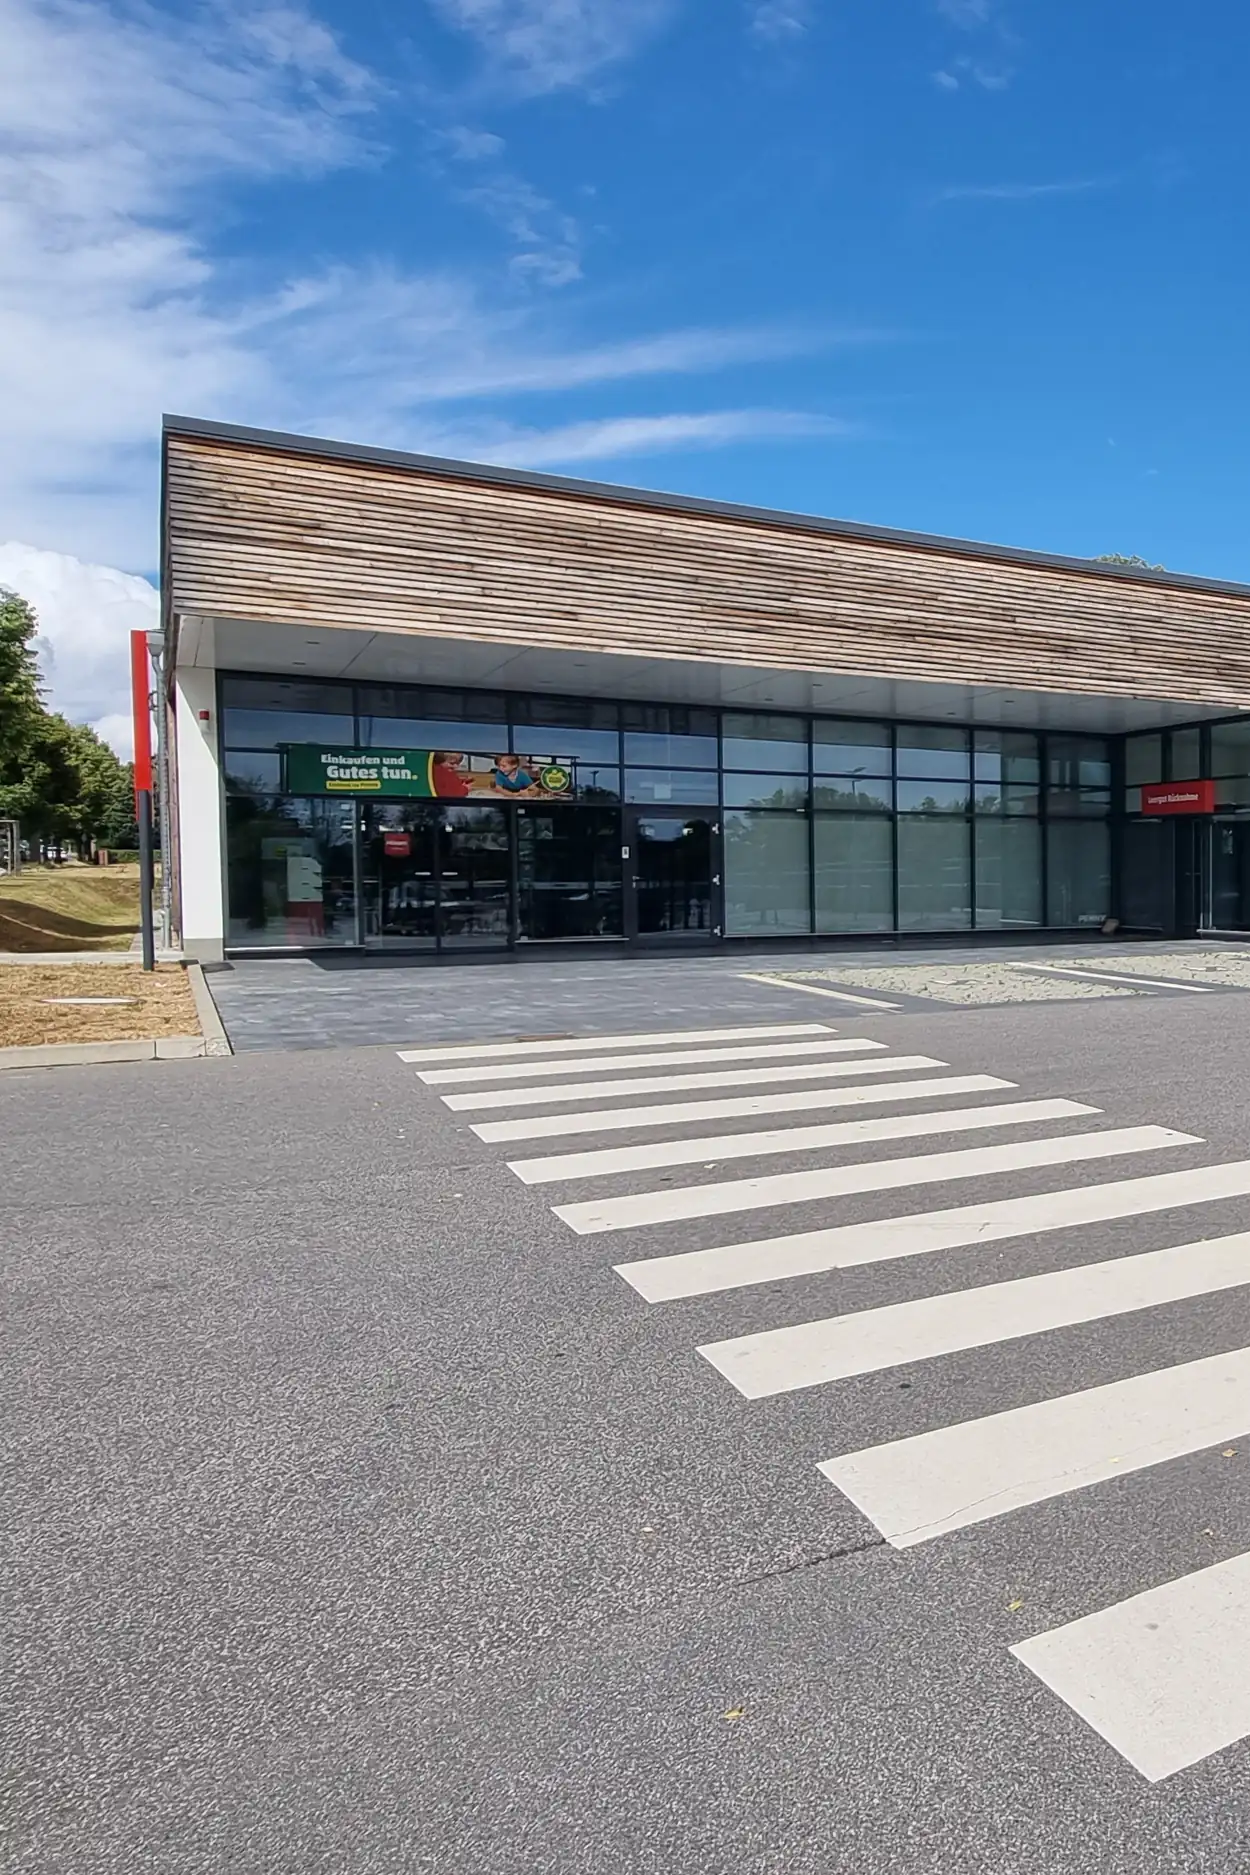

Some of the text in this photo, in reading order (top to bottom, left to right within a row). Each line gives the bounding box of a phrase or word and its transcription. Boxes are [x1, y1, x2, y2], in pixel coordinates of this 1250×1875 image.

[321, 753, 405, 765] Einkaufen und
[326, 765, 418, 780] Gutes tun.
